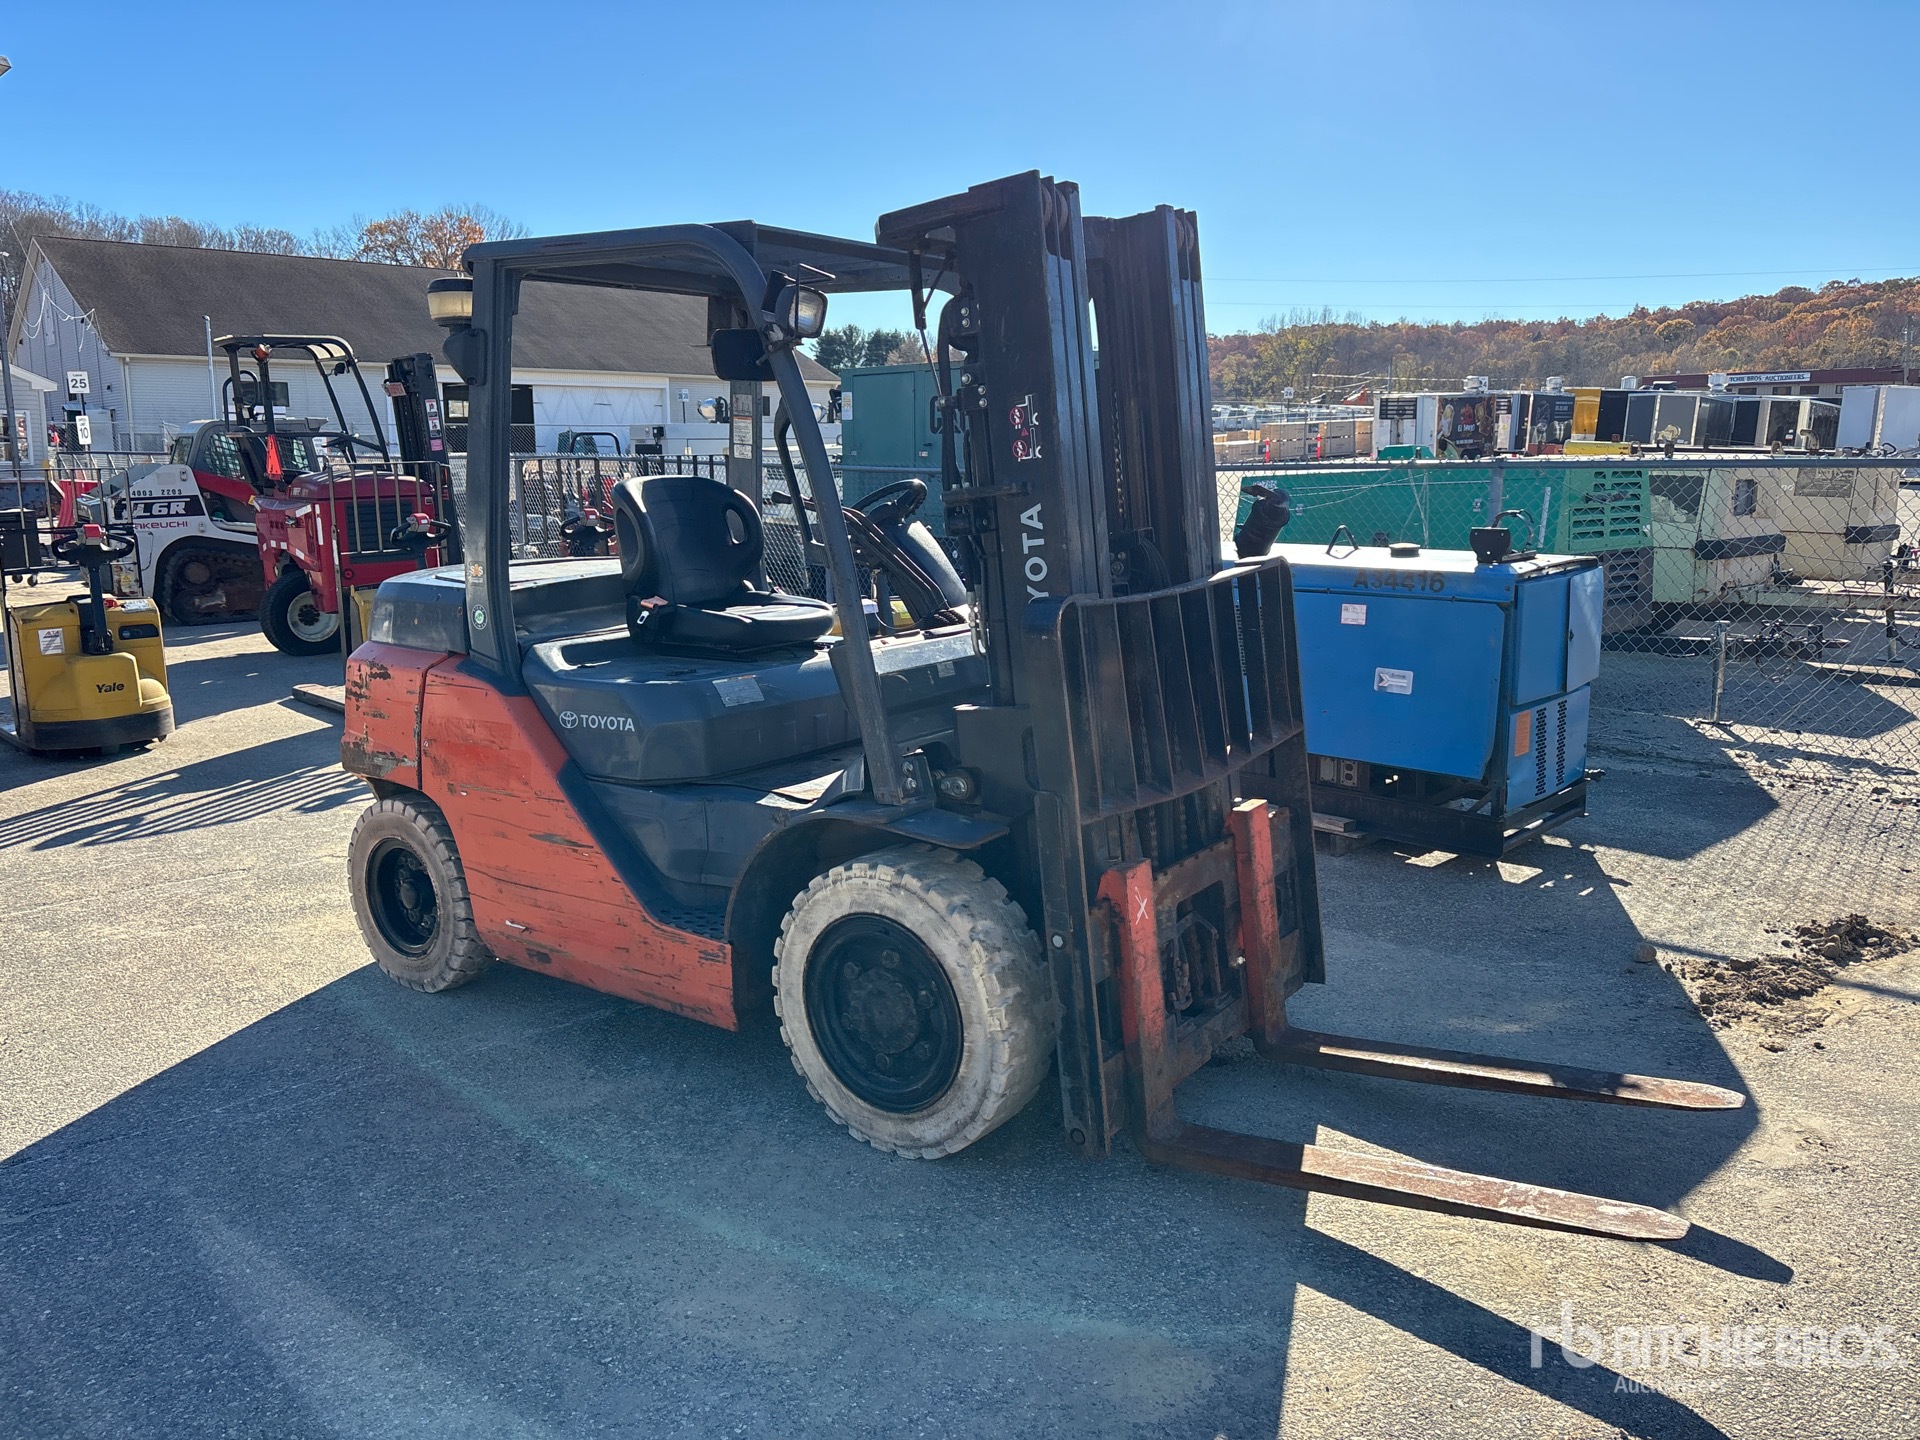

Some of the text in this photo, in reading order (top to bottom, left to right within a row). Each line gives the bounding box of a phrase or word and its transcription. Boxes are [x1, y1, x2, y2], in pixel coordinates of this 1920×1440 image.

[70, 378, 87, 388] 25
[79, 427, 88, 438] 10
[132, 520, 188, 530] AKEUCHI
[1020, 502, 1050, 605] YOTA
[1352, 568, 1446, 593] A34416
[96, 682, 125, 694] Yale
[580, 714, 635, 732] TOYOTA
